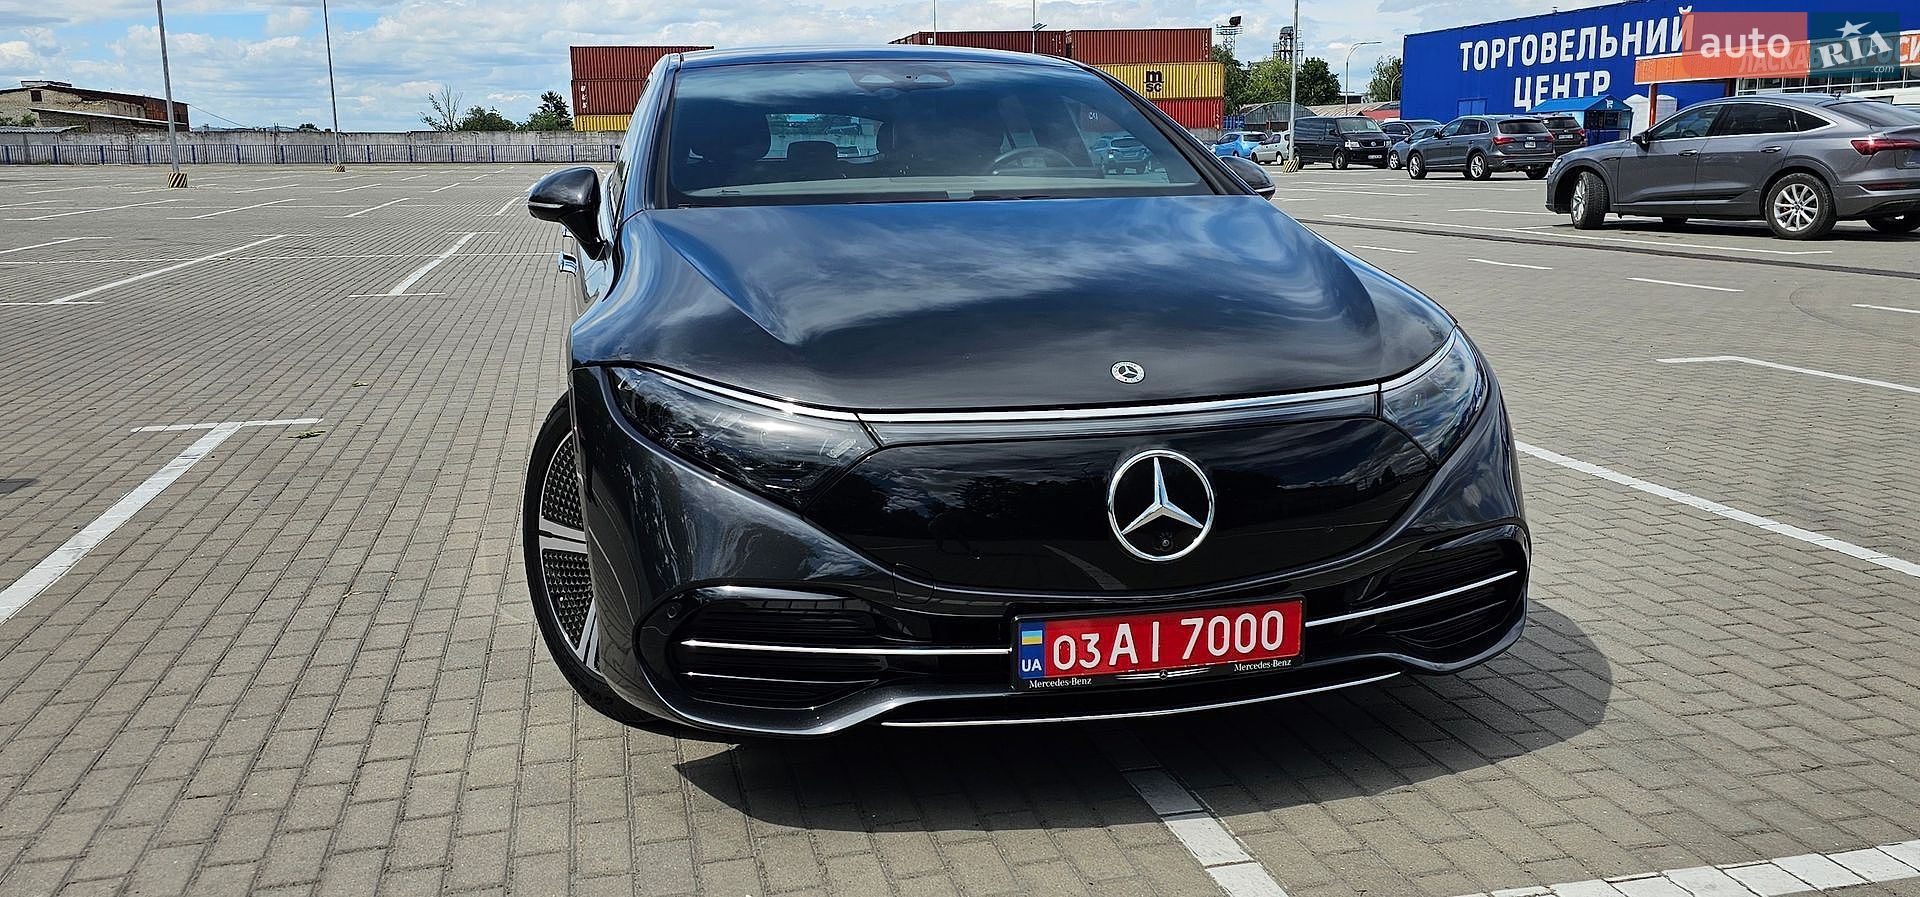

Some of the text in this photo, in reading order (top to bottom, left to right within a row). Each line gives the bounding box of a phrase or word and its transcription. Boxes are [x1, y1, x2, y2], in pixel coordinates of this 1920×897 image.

[1460, 5, 1694, 71] ТОРГОВЕЛЬНИЙ
[1513, 70, 1611, 112] ЦЕНТР
[1021, 658, 1042, 672] UA
[1180, 610, 1284, 660] 7000
[1029, 676, 1092, 689] Mercedes-Benz
[1233, 658, 1292, 672] Mercedes-Benz
